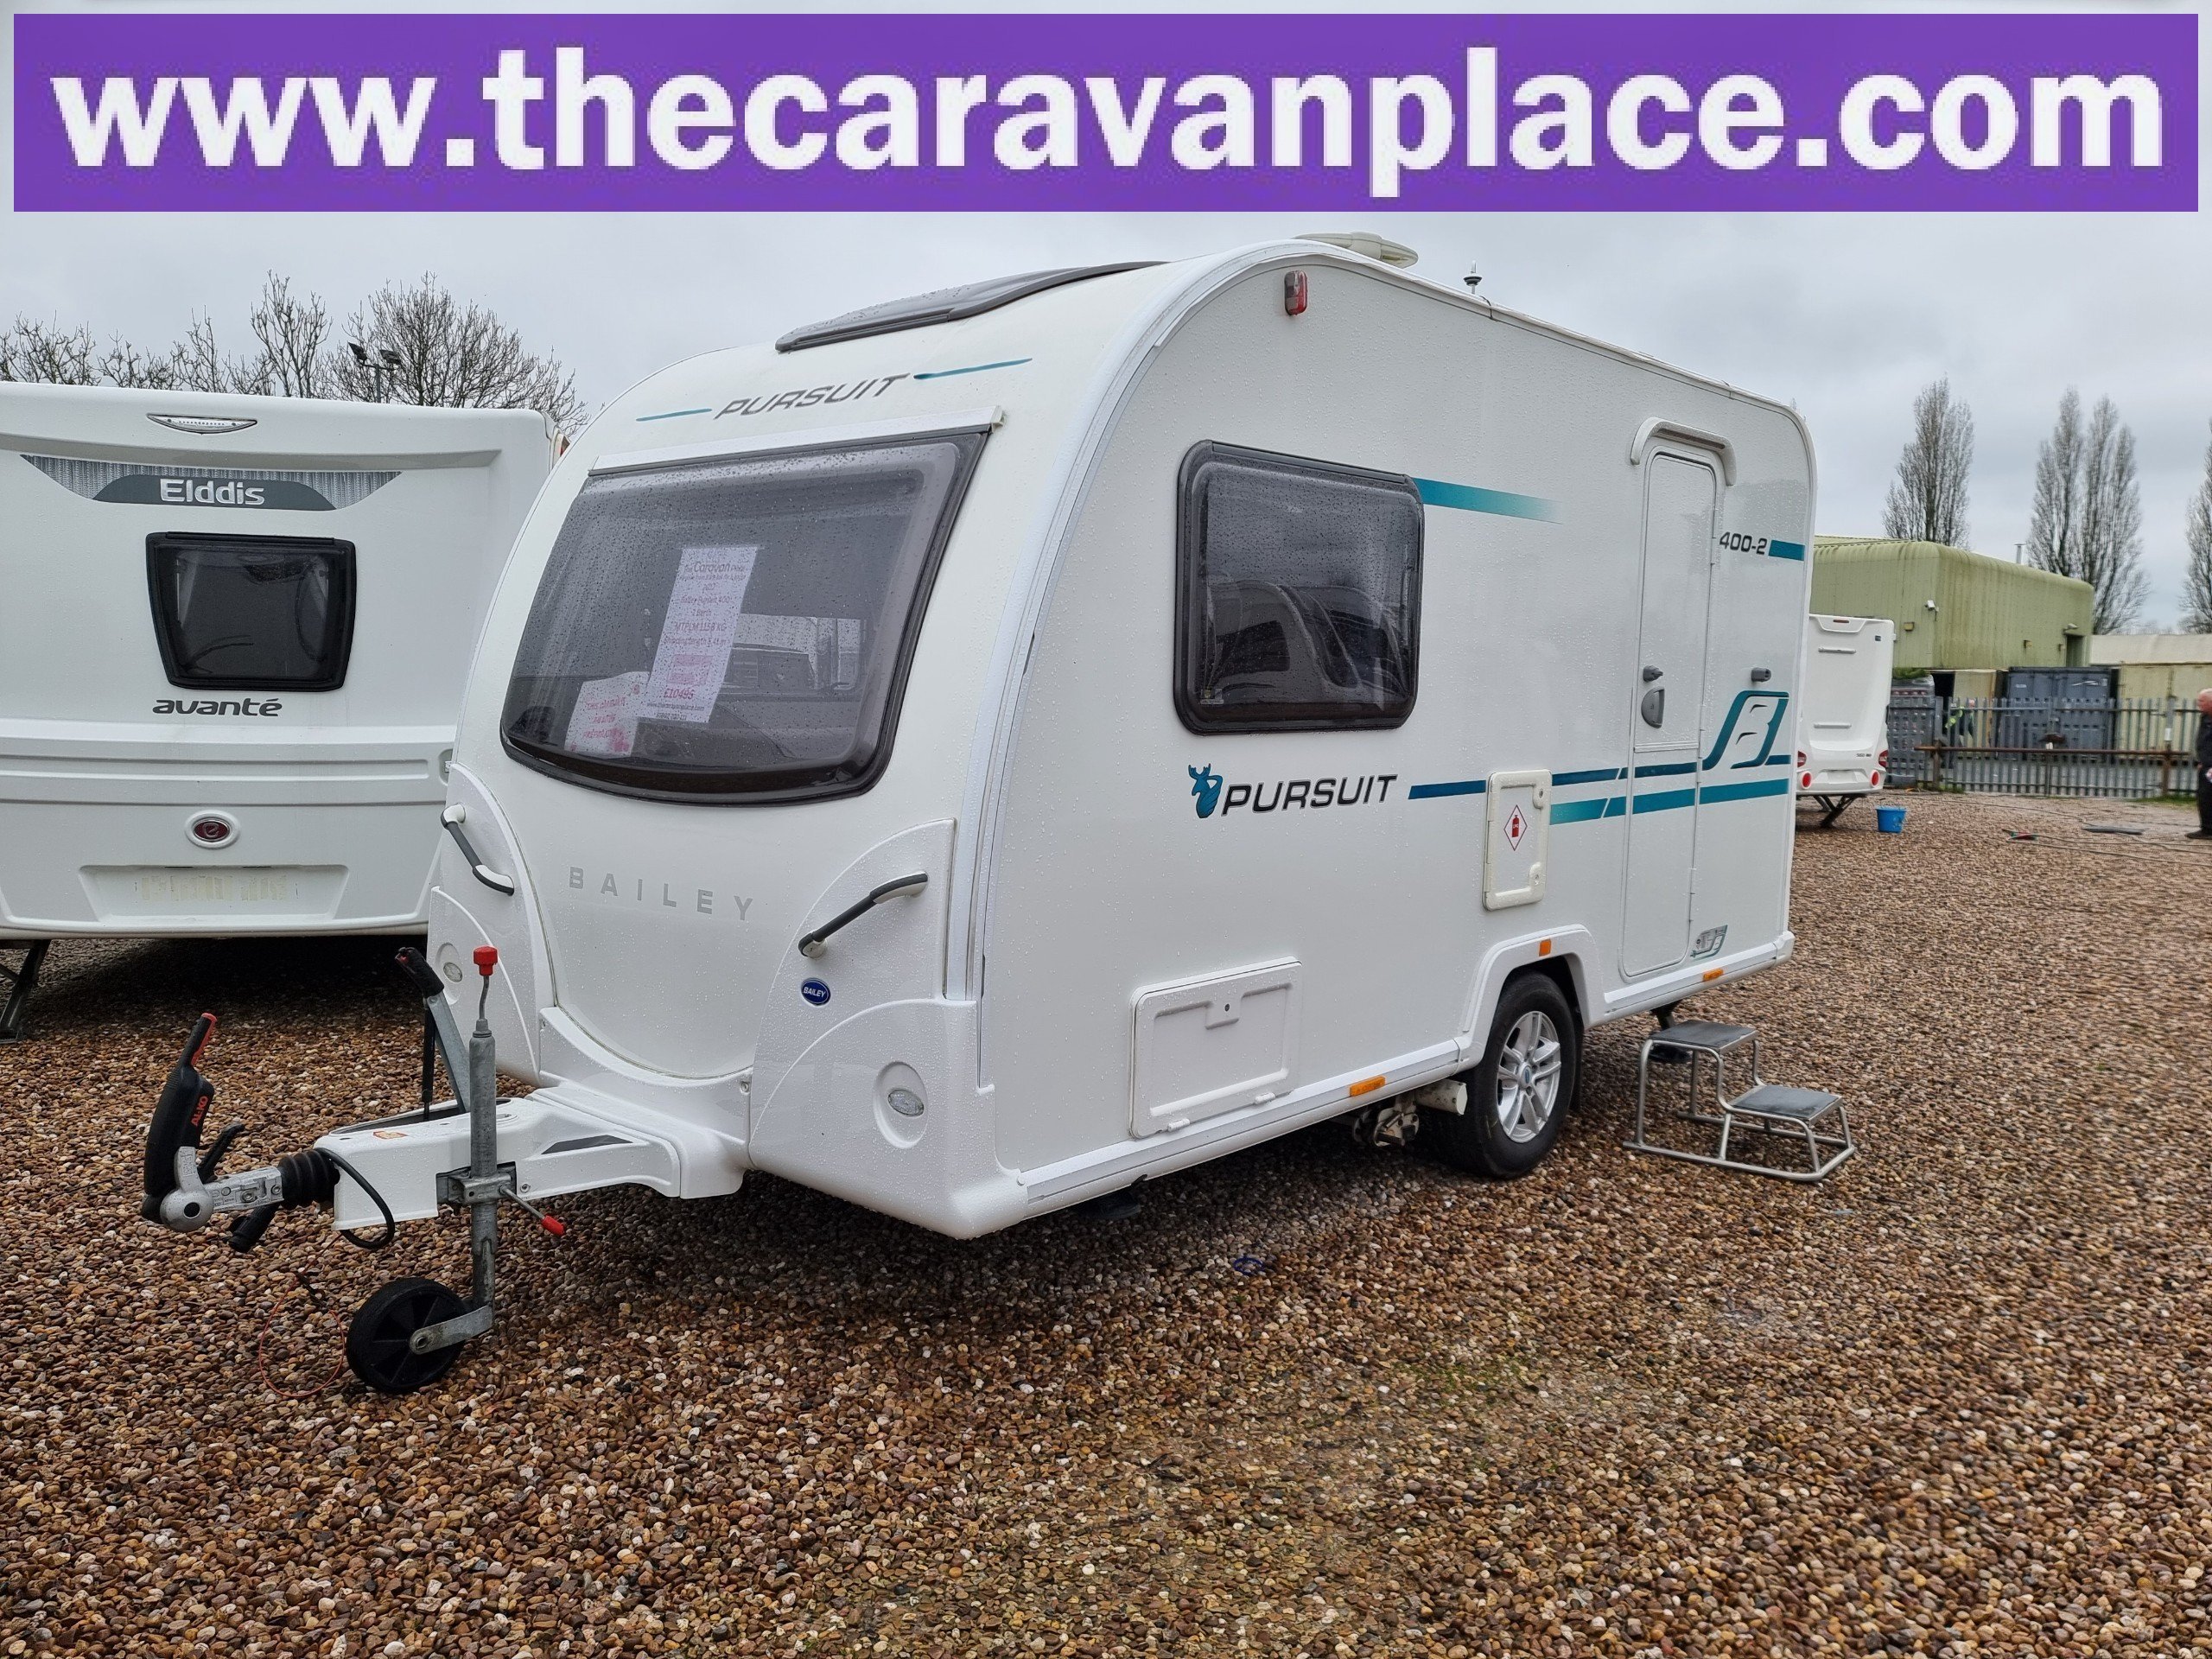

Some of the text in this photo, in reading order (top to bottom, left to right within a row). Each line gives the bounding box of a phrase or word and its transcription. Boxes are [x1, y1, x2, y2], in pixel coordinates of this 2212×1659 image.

[714, 372, 911, 420] PURSUIT
[160, 478, 265, 505] Elddis
[1719, 531, 1767, 555] 400-2
[152, 698, 283, 716] avanté
[1220, 774, 1398, 817] PURSUIT
[569, 867, 753, 920] BAILEY
[804, 987, 826, 998] BAILEY
